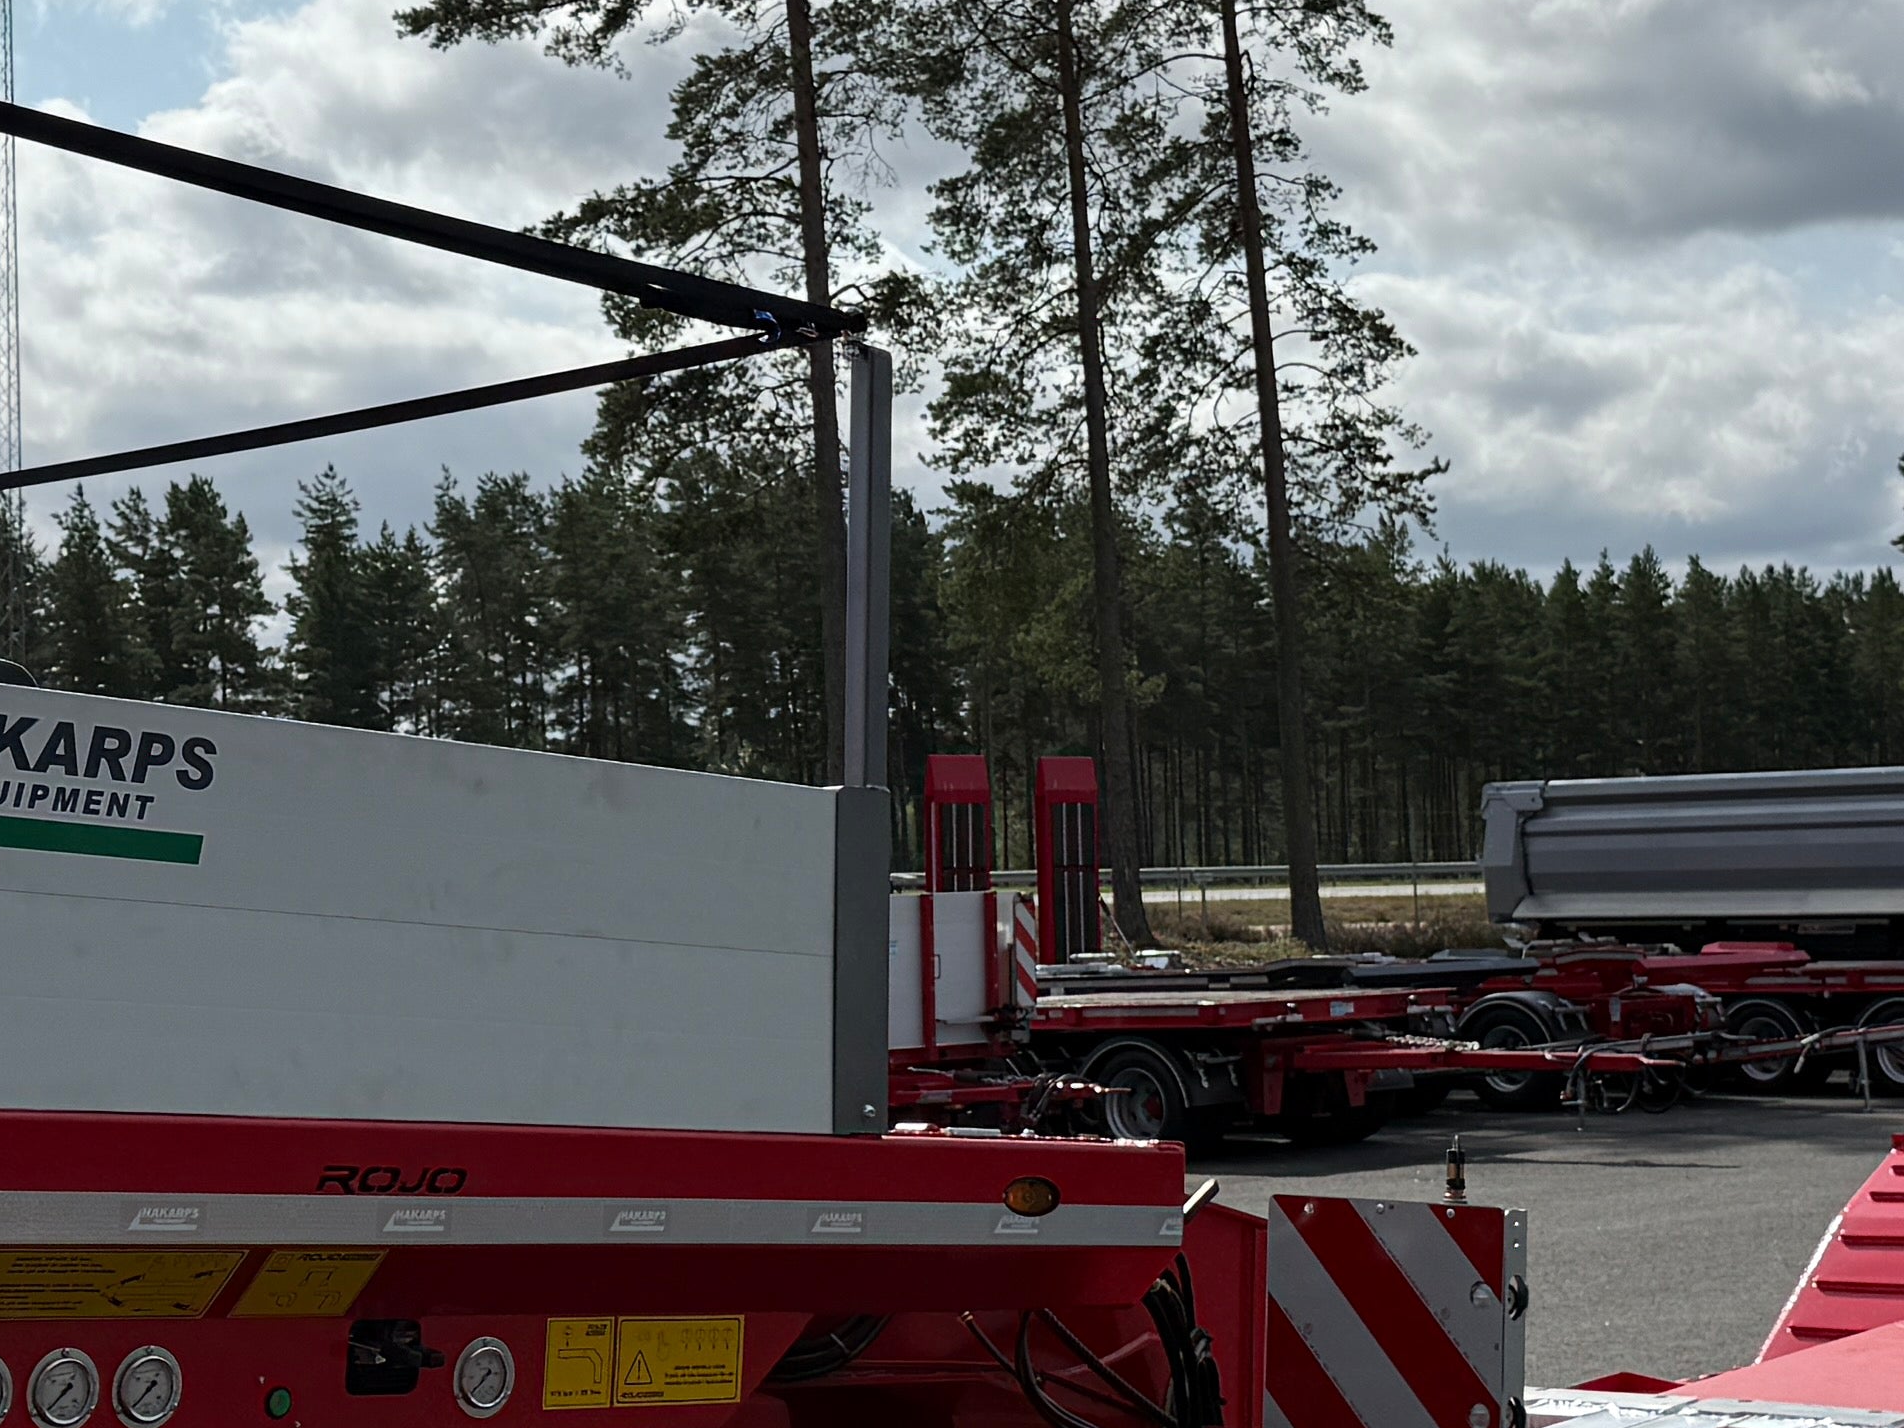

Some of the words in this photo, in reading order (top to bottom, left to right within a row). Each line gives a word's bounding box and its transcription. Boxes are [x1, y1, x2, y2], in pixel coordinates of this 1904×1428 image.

[314, 1164, 470, 1196] ROJO
[140, 1207, 199, 1219] HAKARPS
[395, 1209, 446, 1221] HAKARPS
